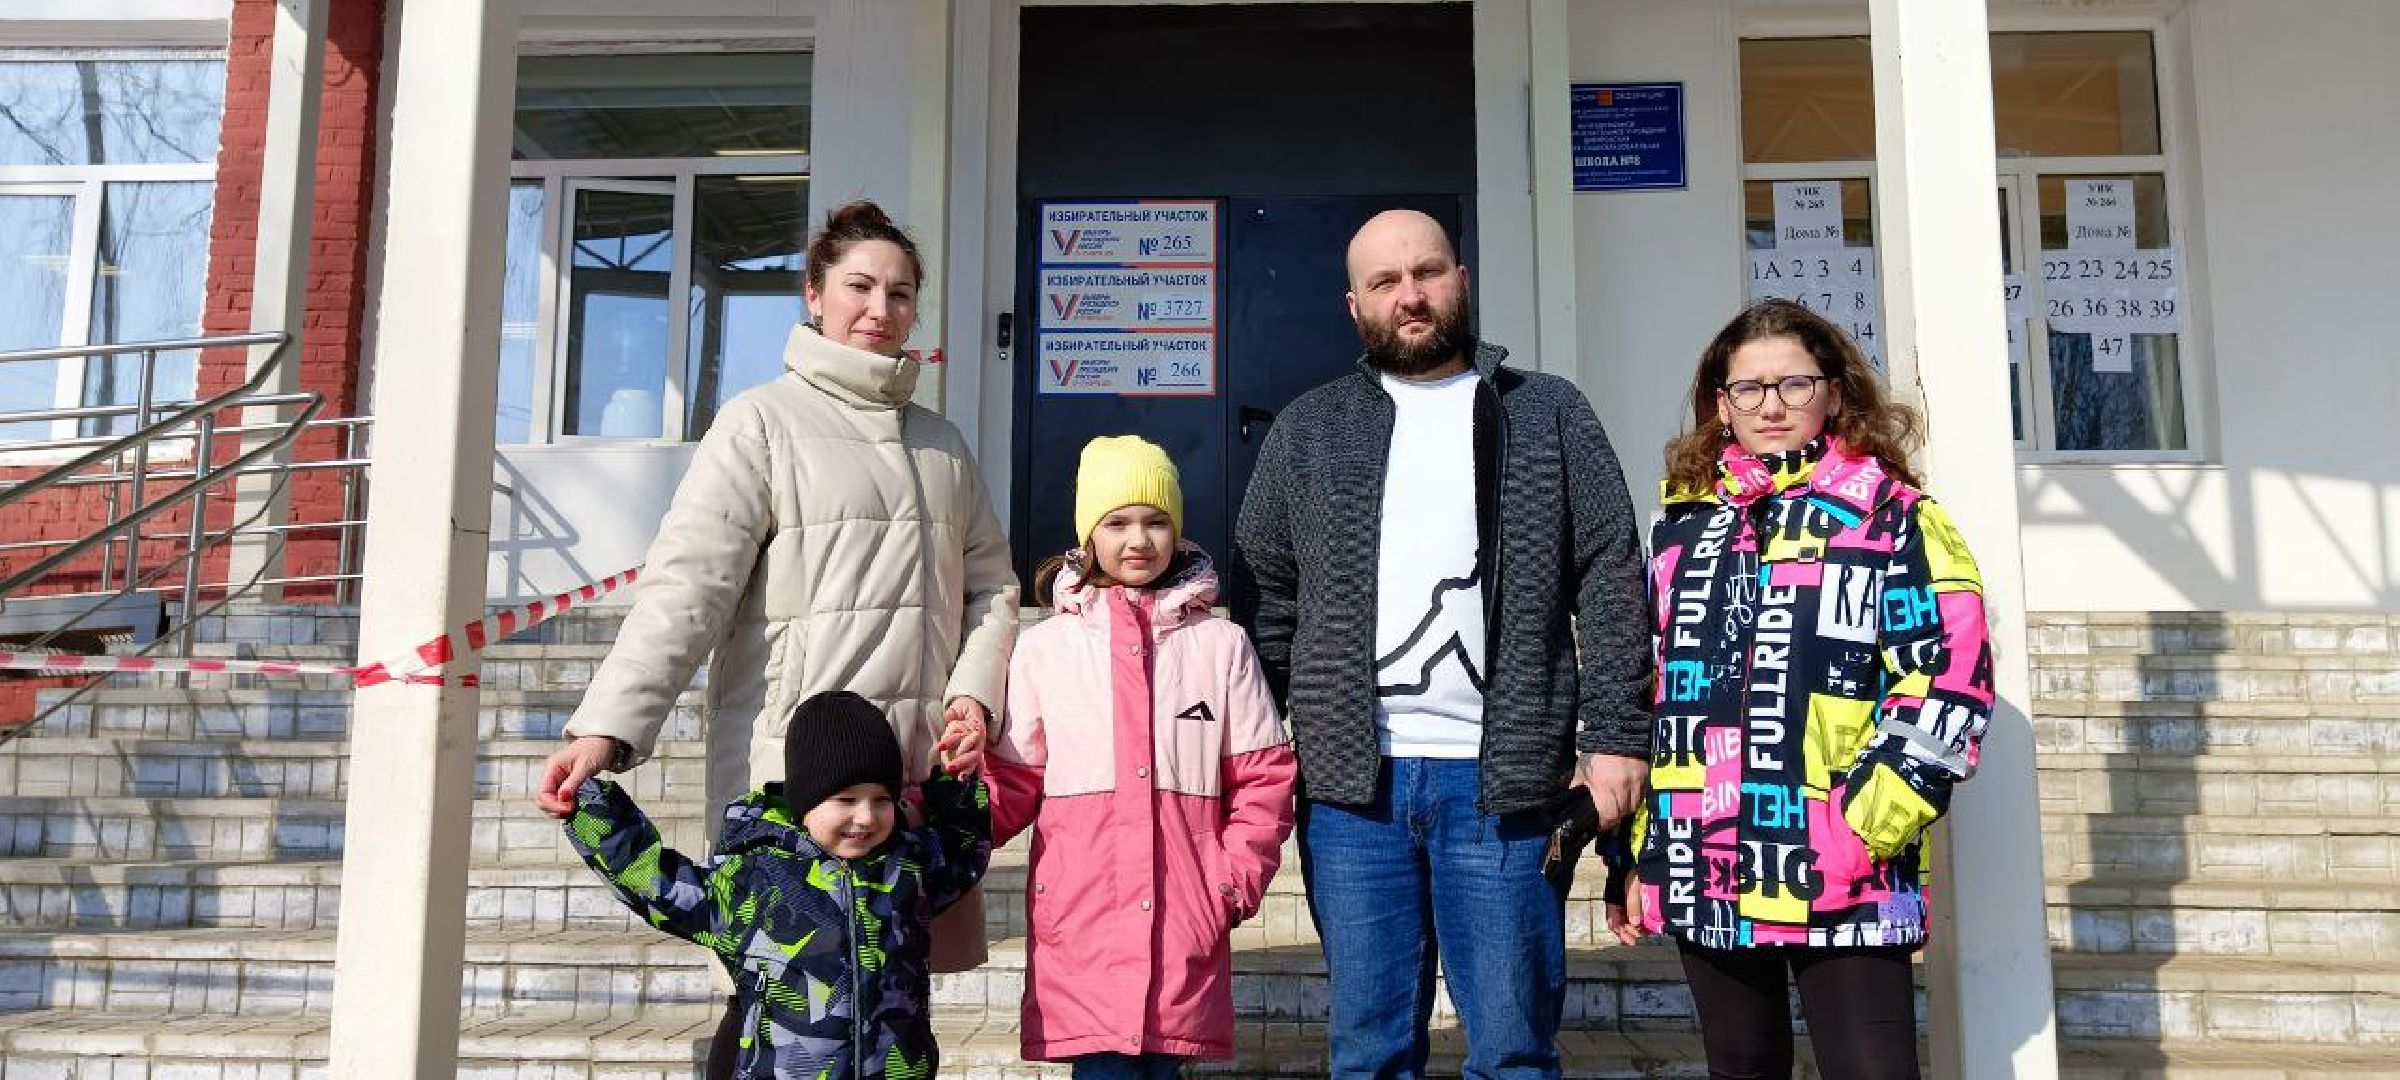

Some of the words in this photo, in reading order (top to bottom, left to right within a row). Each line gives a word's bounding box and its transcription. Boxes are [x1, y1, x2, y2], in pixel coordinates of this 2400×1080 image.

[1574, 156, 1619, 167] ШКОЛА
[1049, 209, 1152, 222] ИЗБИРАТЕЛЬНЫЙ
[1154, 210, 1208, 222] УЧАСТОК
[1785, 226, 1821, 240] Дома
[1824, 225, 1840, 239] №
[2075, 225, 2112, 239] Дома
[2115, 225, 2132, 238] №
[1139, 237, 1159, 256] №
[1163, 235, 1191, 250] 265
[1791, 259, 1805, 278] 2
[1817, 259, 1829, 278] 3
[1849, 257, 1864, 276] 4
[2045, 260, 2071, 280] 22
[2078, 259, 2104, 278] 23
[2114, 260, 2139, 280] 24
[2146, 259, 2172, 280] 25
[1047, 273, 1150, 286] ИЗБИРАТЕЛЬНЫЙ
[1153, 274, 1208, 286] УЧАСТОК
[1137, 302, 1157, 320] №
[1163, 300, 1202, 316] 3727
[1821, 293, 1832, 310] 7
[1855, 291, 1866, 310] 8
[2049, 299, 2074, 317] 26
[2082, 298, 2108, 317] 36
[2115, 299, 2142, 318] 38
[2149, 299, 2175, 318] 39
[1853, 321, 1875, 340] 14
[1045, 339, 1150, 351] ИЗБИРАТЕЛЬНЫЙ
[1152, 340, 1208, 351] УЧАСТОК
[2099, 338, 2123, 356] 47
[1137, 366, 1157, 386] №
[1170, 361, 1201, 377] 266
[1749, 585, 1797, 771] FULLRIDE
